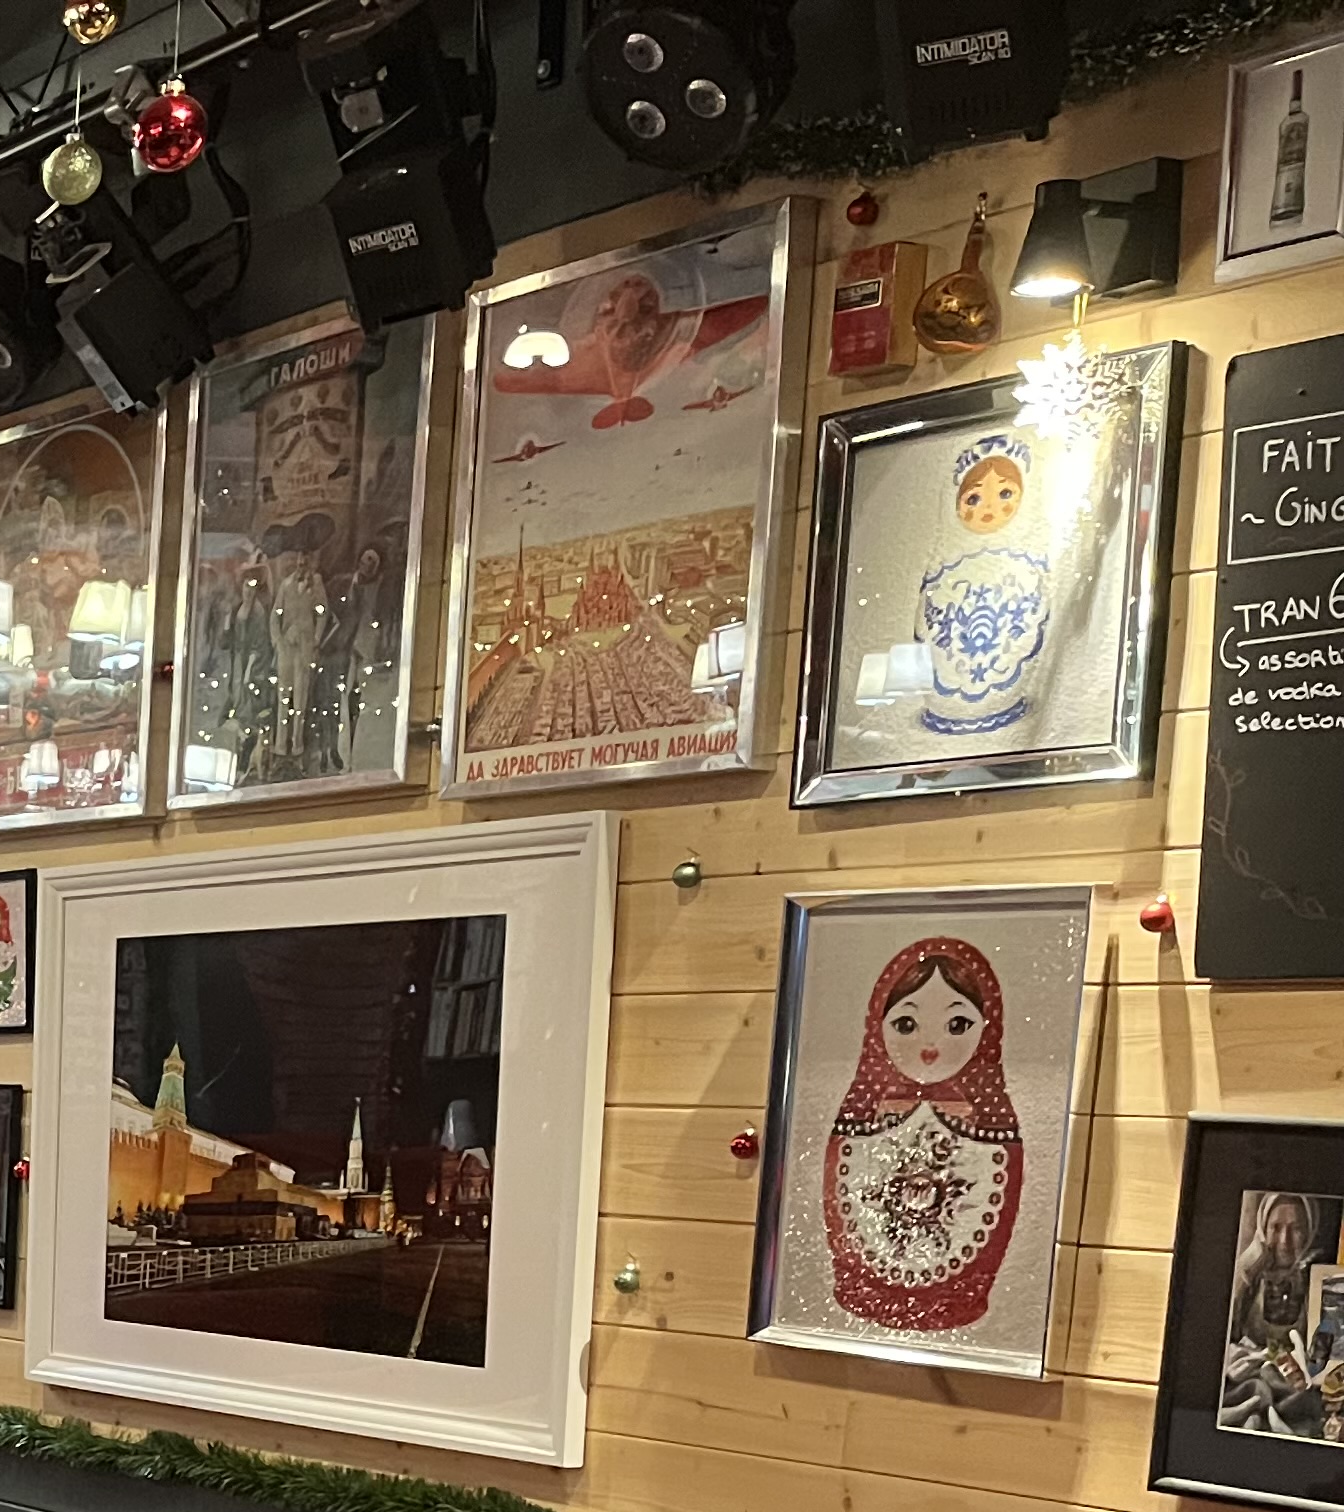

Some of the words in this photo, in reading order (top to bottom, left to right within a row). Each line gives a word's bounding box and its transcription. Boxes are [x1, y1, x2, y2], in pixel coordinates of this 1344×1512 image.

[915, 30, 1009, 64] INTIMIDATOR
[270, 342, 352, 388] ГАЛОШИ
[1228, 687, 1259, 706] de
[1268, 681, 1342, 701] vodka
[490, 748, 585, 779] ЗДРАВСТВУЕТ
[590, 738, 660, 768] МОГУЧАЯ
[666, 728, 738, 759] АВИАЦИЯ
